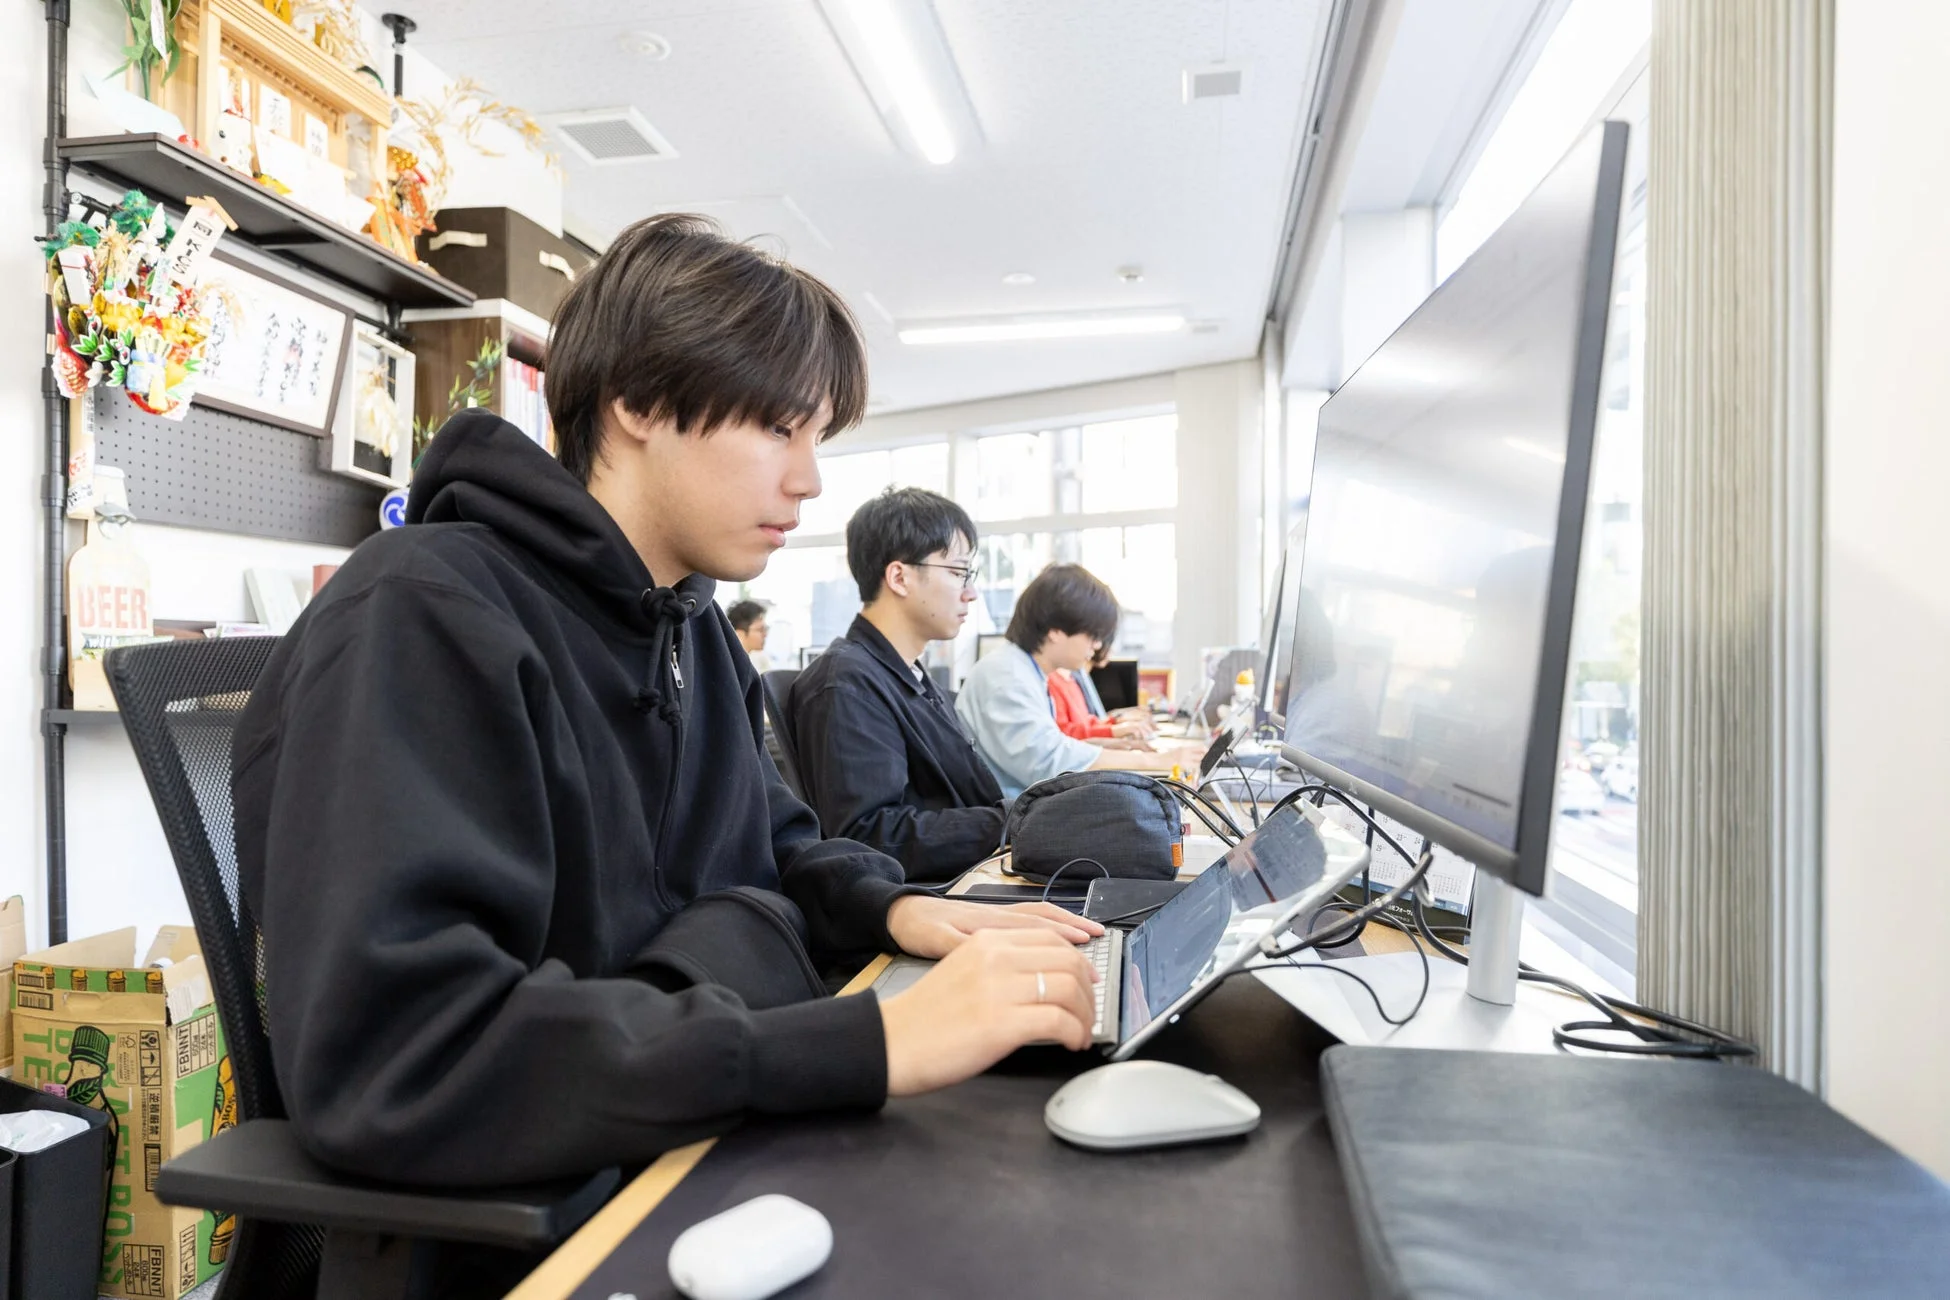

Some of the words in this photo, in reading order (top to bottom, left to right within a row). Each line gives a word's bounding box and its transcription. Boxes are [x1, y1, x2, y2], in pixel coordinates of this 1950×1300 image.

[77, 585, 147, 630] BEER
[178, 1027, 190, 1074] FBNNT
[150, 1248, 162, 1294] FBNNT
